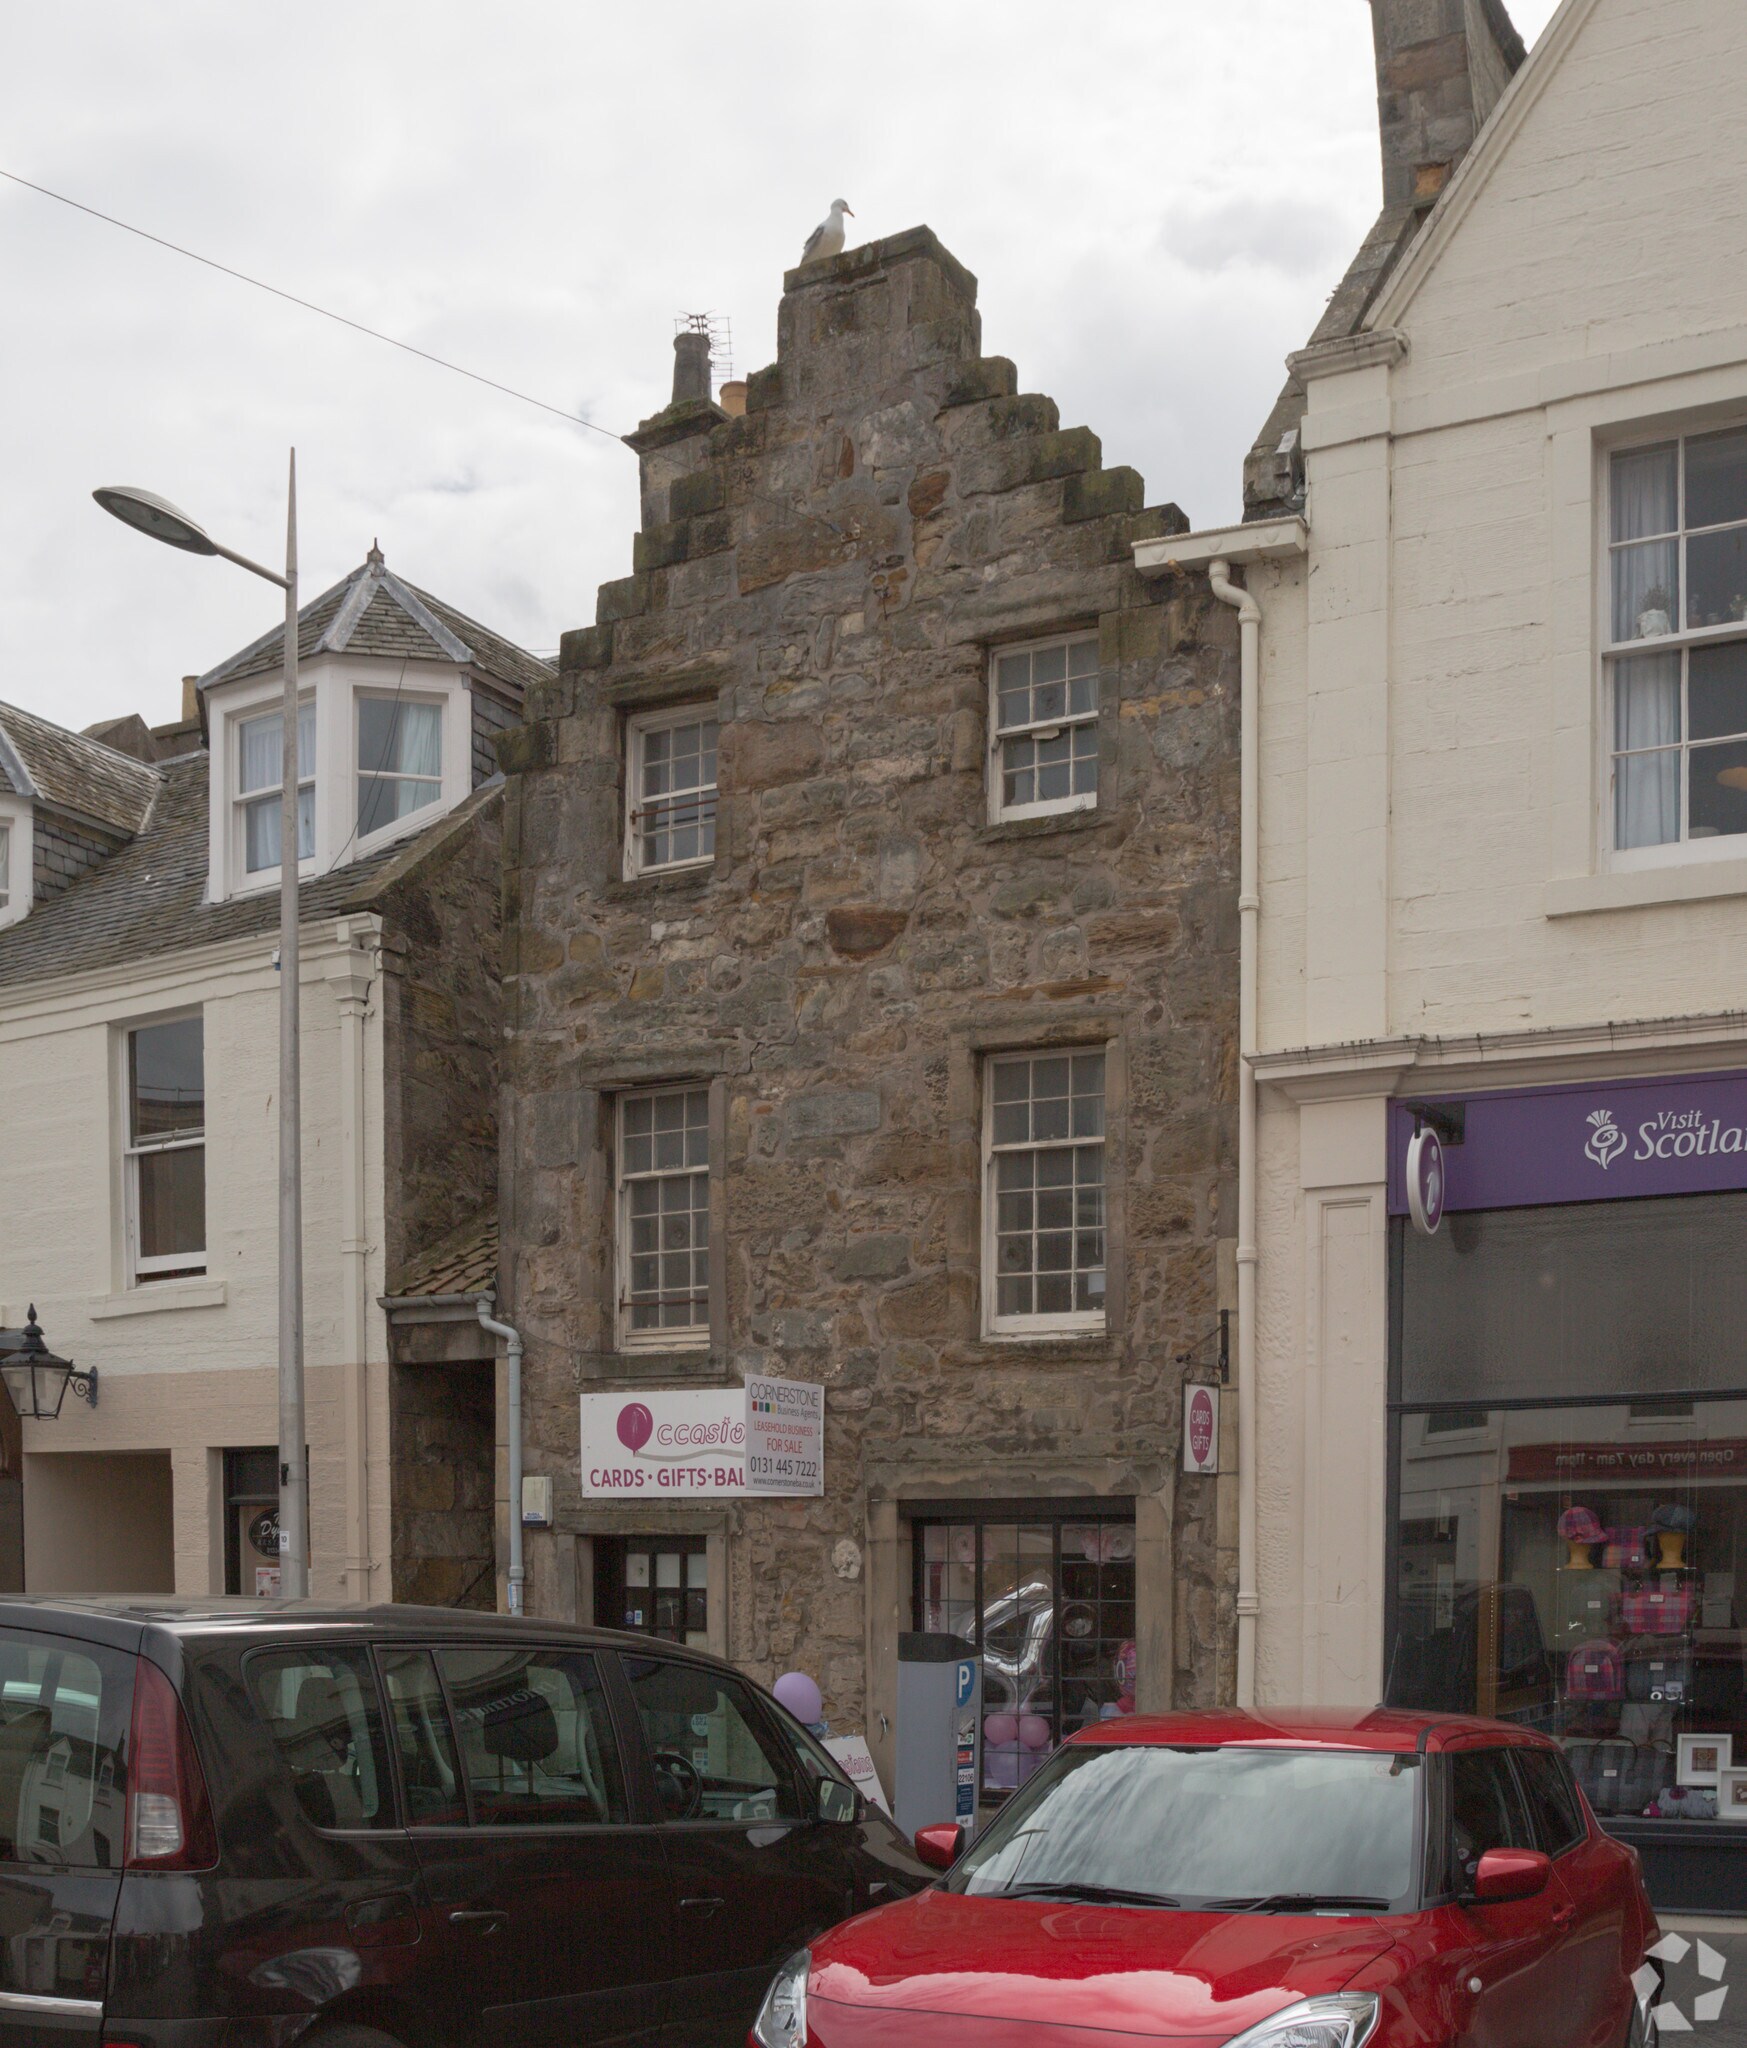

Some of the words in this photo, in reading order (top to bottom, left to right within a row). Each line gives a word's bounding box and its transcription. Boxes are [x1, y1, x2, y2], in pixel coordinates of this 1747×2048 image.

[1656, 1109, 1703, 1131] Visit
[1633, 1119, 1747, 1161] Scotla
[750, 1382, 819, 1407] CORNERSTONE
[777, 1405, 799, 1417] Business
[800, 1408, 818, 1420] Agents
[1191, 1410, 1210, 1425] CARDS
[754, 1420, 788, 1434] LEASEHOLD
[788, 1424, 813, 1437] BUSINESS
[766, 1437, 783, 1452] FOR
[784, 1439, 803, 1454] SALE
[1192, 1435, 1210, 1451] GIFTS
[750, 1456, 773, 1473] 0131
[776, 1459, 793, 1476] 445
[795, 1460, 817, 1477] 7222
[590, 1468, 645, 1488] CARDS
[657, 1467, 709, 1487] GIFTS
